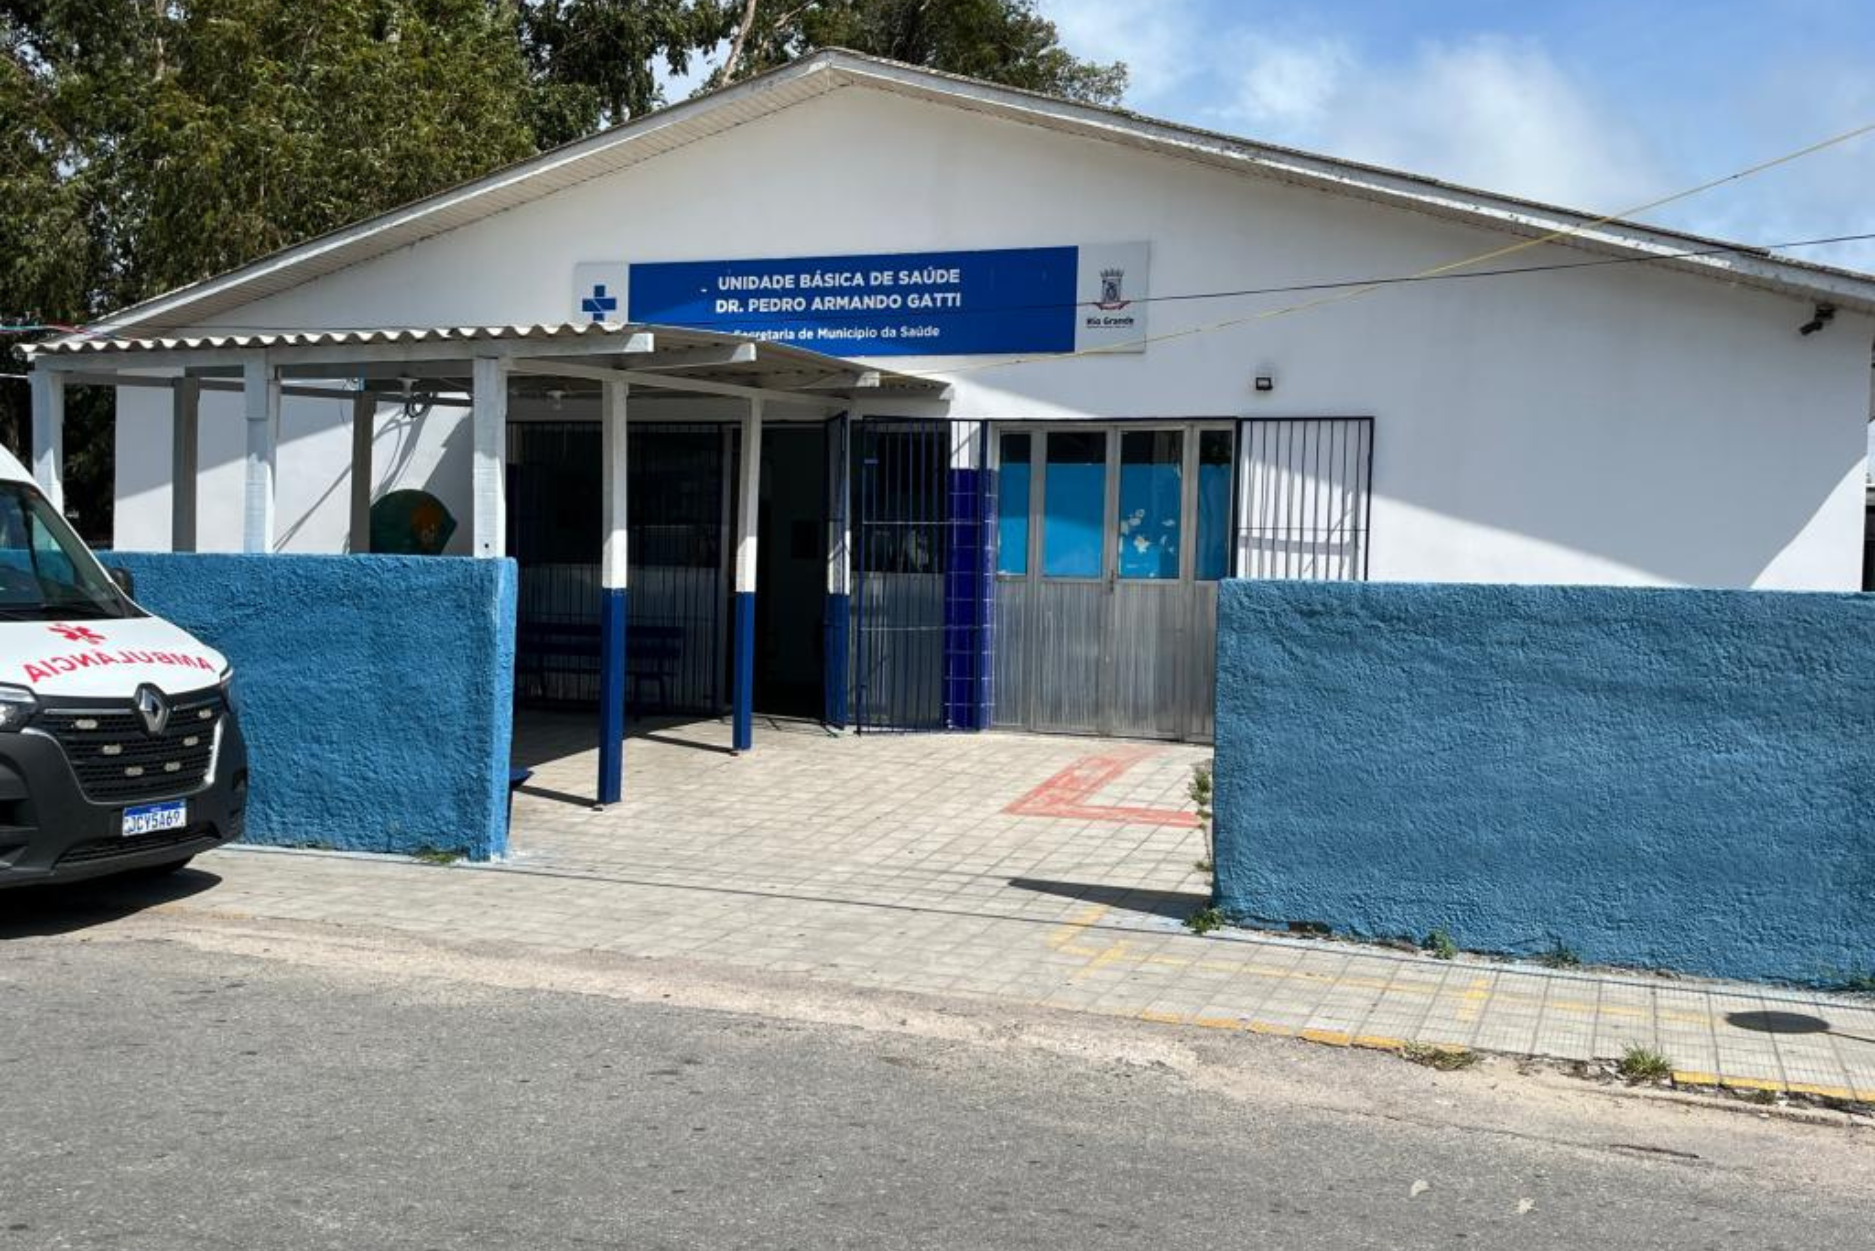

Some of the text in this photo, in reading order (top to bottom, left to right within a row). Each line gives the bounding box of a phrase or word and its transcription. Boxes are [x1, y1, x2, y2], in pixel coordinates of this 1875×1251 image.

[718, 266, 961, 291] UNIDADE BÁSICA DE SAÚDE
[715, 291, 962, 314] DR. PEDRO ARMANDO GATTI
[1087, 317, 1134, 325] Rio Grande
[798, 327, 814, 340] de
[881, 325, 897, 338] da
[900, 324, 941, 338] Saúde
